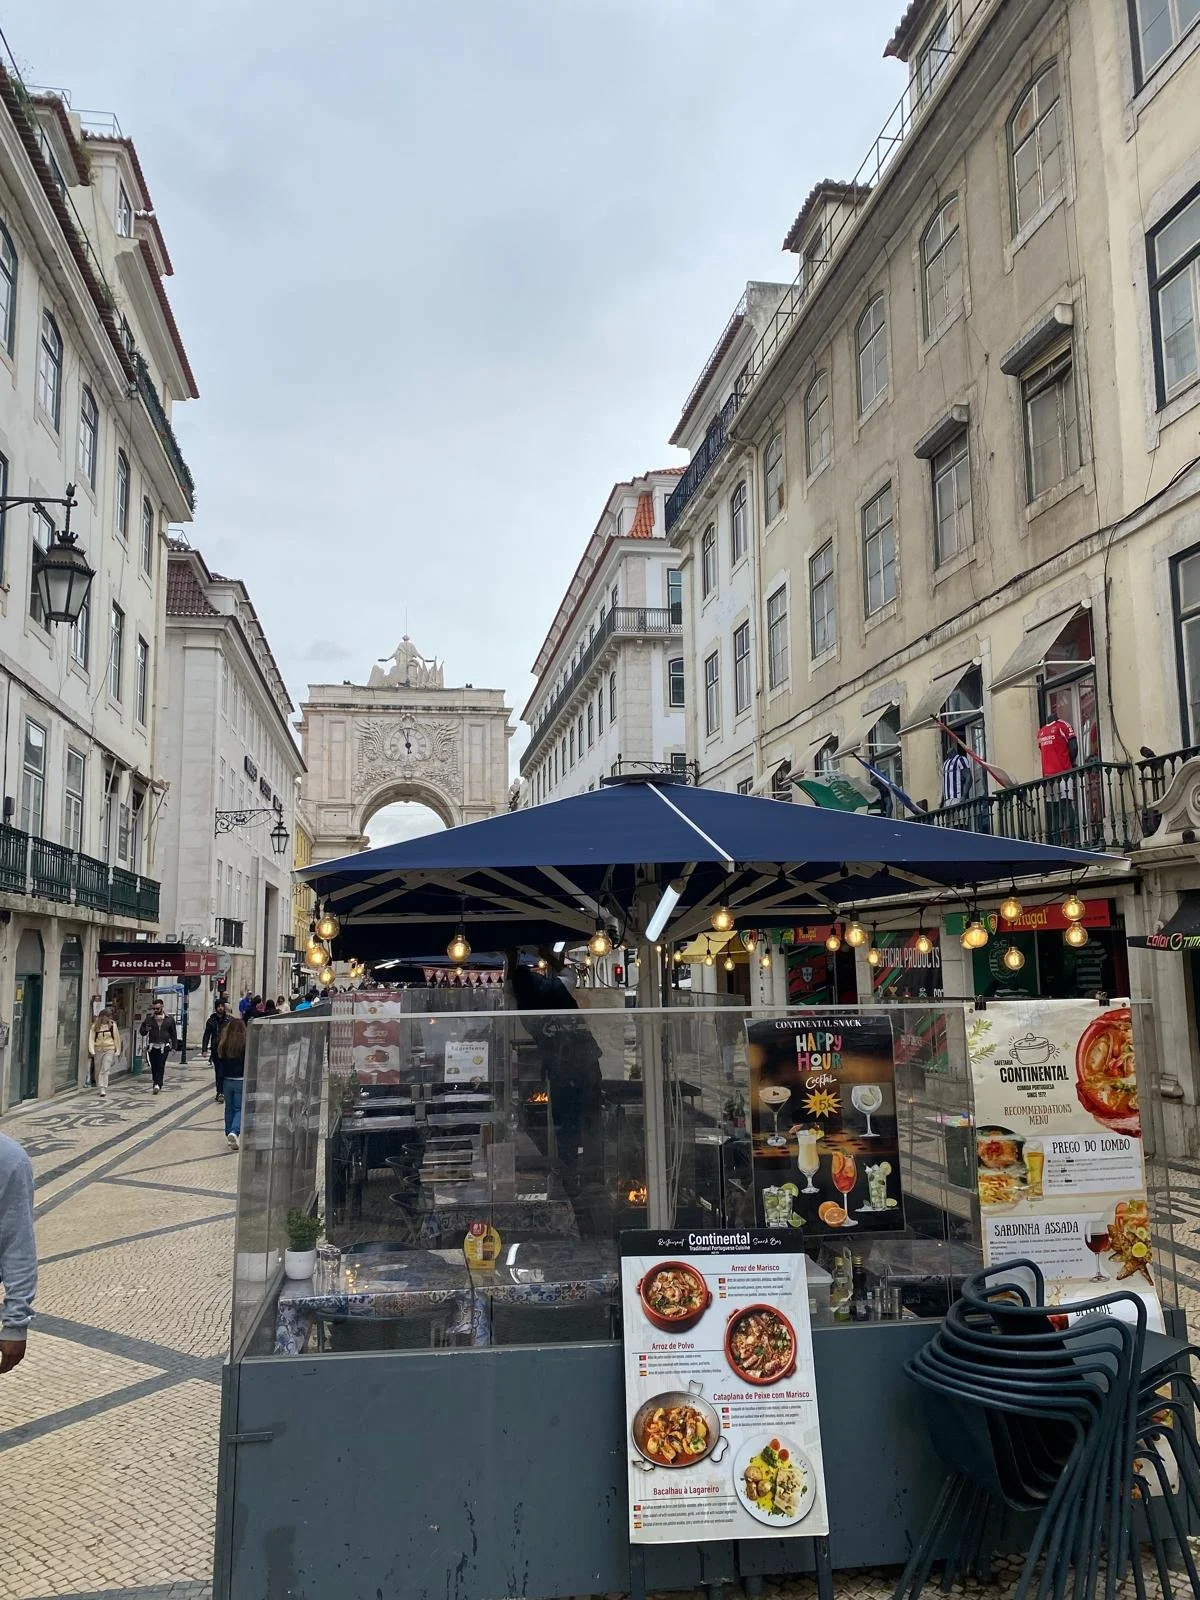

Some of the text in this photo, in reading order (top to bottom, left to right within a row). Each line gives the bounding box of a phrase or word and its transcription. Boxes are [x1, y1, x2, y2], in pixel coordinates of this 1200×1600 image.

[111, 959, 172, 968] Pastelaria
[775, 1019, 862, 1029] CONTINENTAL SNACK
[795, 1032, 843, 1052] HAPPY
[797, 1053, 843, 1072] HOUR
[1000, 1065, 1069, 1083] CONTINENTAL
[1004, 1104, 1072, 1116] RECOMMENDATIONS
[1029, 1115, 1049, 1125] MENU
[1052, 1138, 1131, 1154] PREGO DO LOMBO
[994, 1221, 1079, 1237] SARDINHA ASSADA
[688, 1232, 751, 1245] Continental
[713, 1393, 744, 1402] Cataplana
[754, 1392, 770, 1400] Peixe
[786, 1391, 810, 1399] Marisco
[683, 1486, 688, 1494] à
[689, 1486, 720, 1495] Lagareiro
